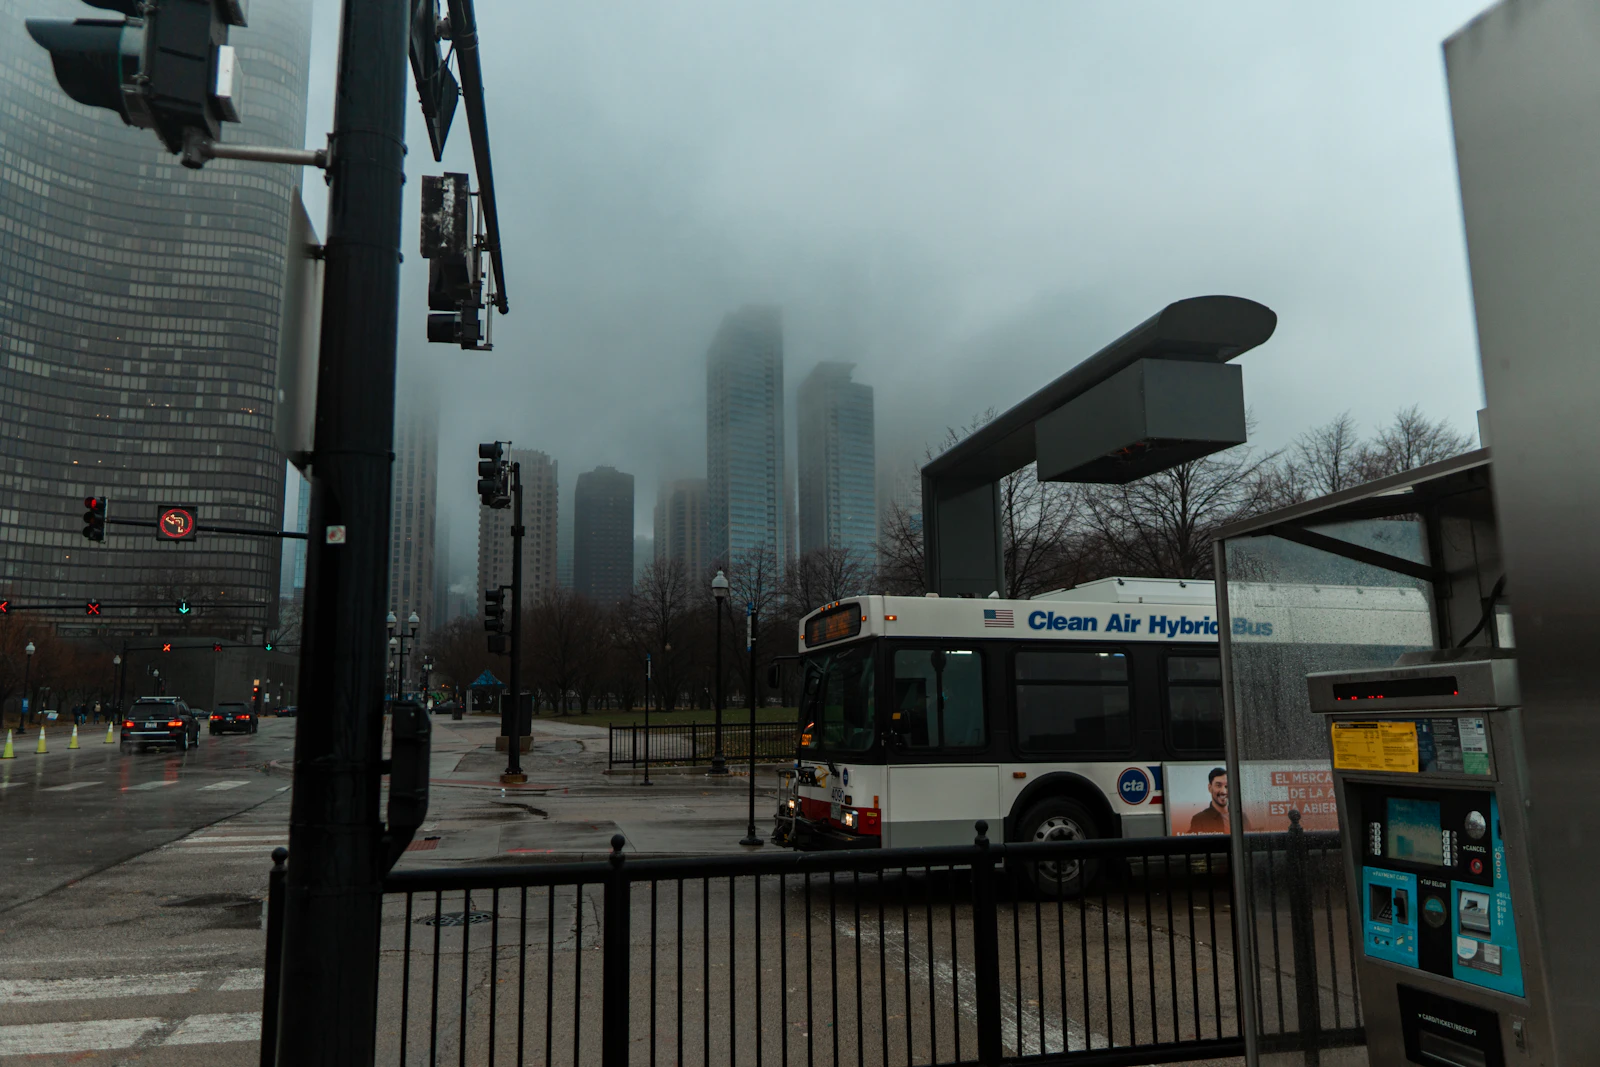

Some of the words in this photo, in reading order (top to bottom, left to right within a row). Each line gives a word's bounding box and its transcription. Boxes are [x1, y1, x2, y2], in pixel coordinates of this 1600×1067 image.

[1028, 611, 1097, 631] Clean
[1105, 614, 1140, 633] Air
[1232, 617, 1273, 636] Bus
[1275, 773, 1289, 784] EL
[1122, 778, 1144, 792] cta
[831, 788, 844, 803] 4090
[1290, 788, 1306, 799] DE
[1309, 788, 1324, 799] LA
[1466, 844, 1487, 853] CANCEL
[1375, 871, 1395, 879] PAYMENT
[1432, 880, 1447, 888] BELOW
[1496, 899, 1507, 907] $20
